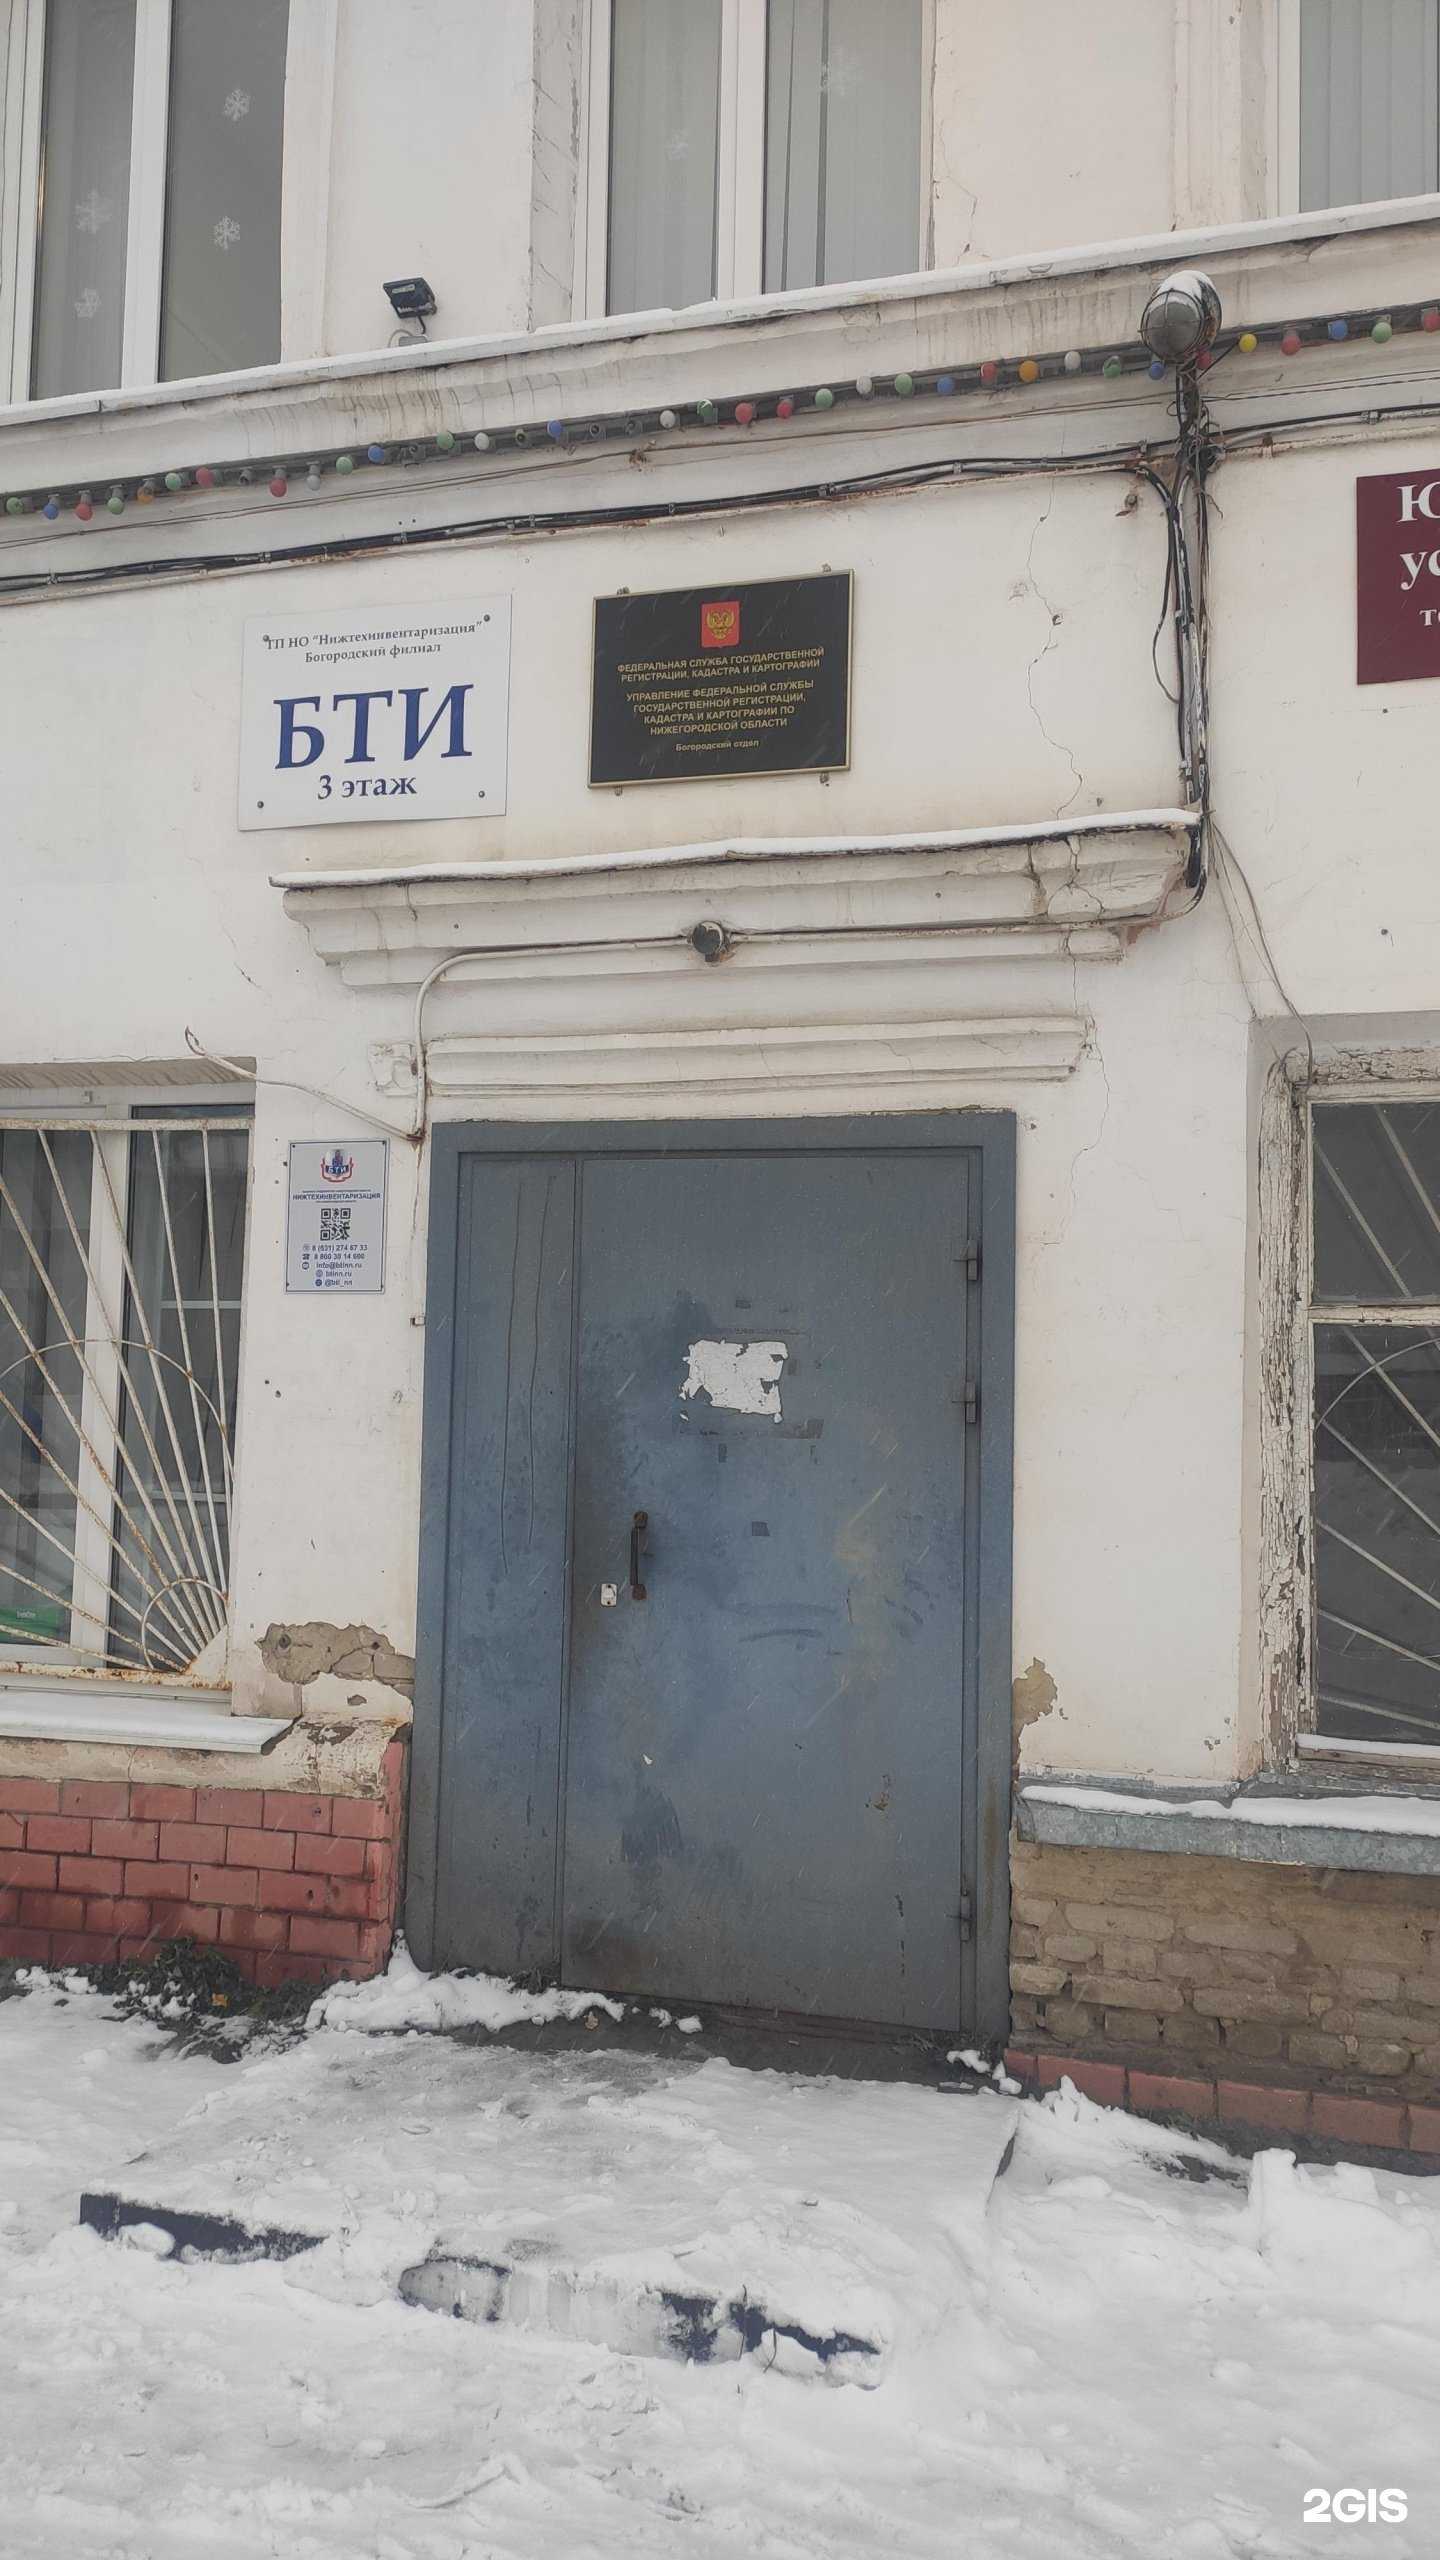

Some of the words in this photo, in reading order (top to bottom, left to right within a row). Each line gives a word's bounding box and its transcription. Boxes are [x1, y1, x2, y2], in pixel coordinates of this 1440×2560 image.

[288, 636, 309, 648] НО
[305, 647, 386, 663] Богородский
[389, 644, 441, 659] филиал
[617, 660, 687, 673] ФЕДЕРАЛЬНАЯ
[689, 656, 728, 668] СЛУЖБА
[730, 646, 824, 664] ГОСУДАРСТВЕННОЙ
[691, 666, 741, 678] КАДАСТРА
[743, 665, 750, 674] И
[751, 659, 820, 673] КАРТОГРАФИИ
[626, 689, 691, 702] УПРАВЛЕНИЕ
[692, 682, 767, 698] ФЕДЕРАЛЬНОЙ
[769, 680, 814, 691] СЛУЖБЫ
[633, 698, 730, 713] ГОСУДАРСТВЕННОЙ
[733, 693, 806, 706] РЕГИСТРАЦИИ,
[644, 713, 695, 724] КАДАСТРА
[697, 713, 704, 721] И
[706, 706, 778, 720] КАРТОГРАФИИ
[780, 705, 795, 715] ПО
[273, 684, 474, 769] БТИ
[650, 721, 738, 736] НИЖЕГОРОДСКОЙ
[740, 718, 788, 729] ОБЛАСТИ
[675, 741, 731, 752] Богородский
[734, 740, 760, 748] отдел
[317, 774, 332, 800] 3
[341, 775, 418, 798] этаж
